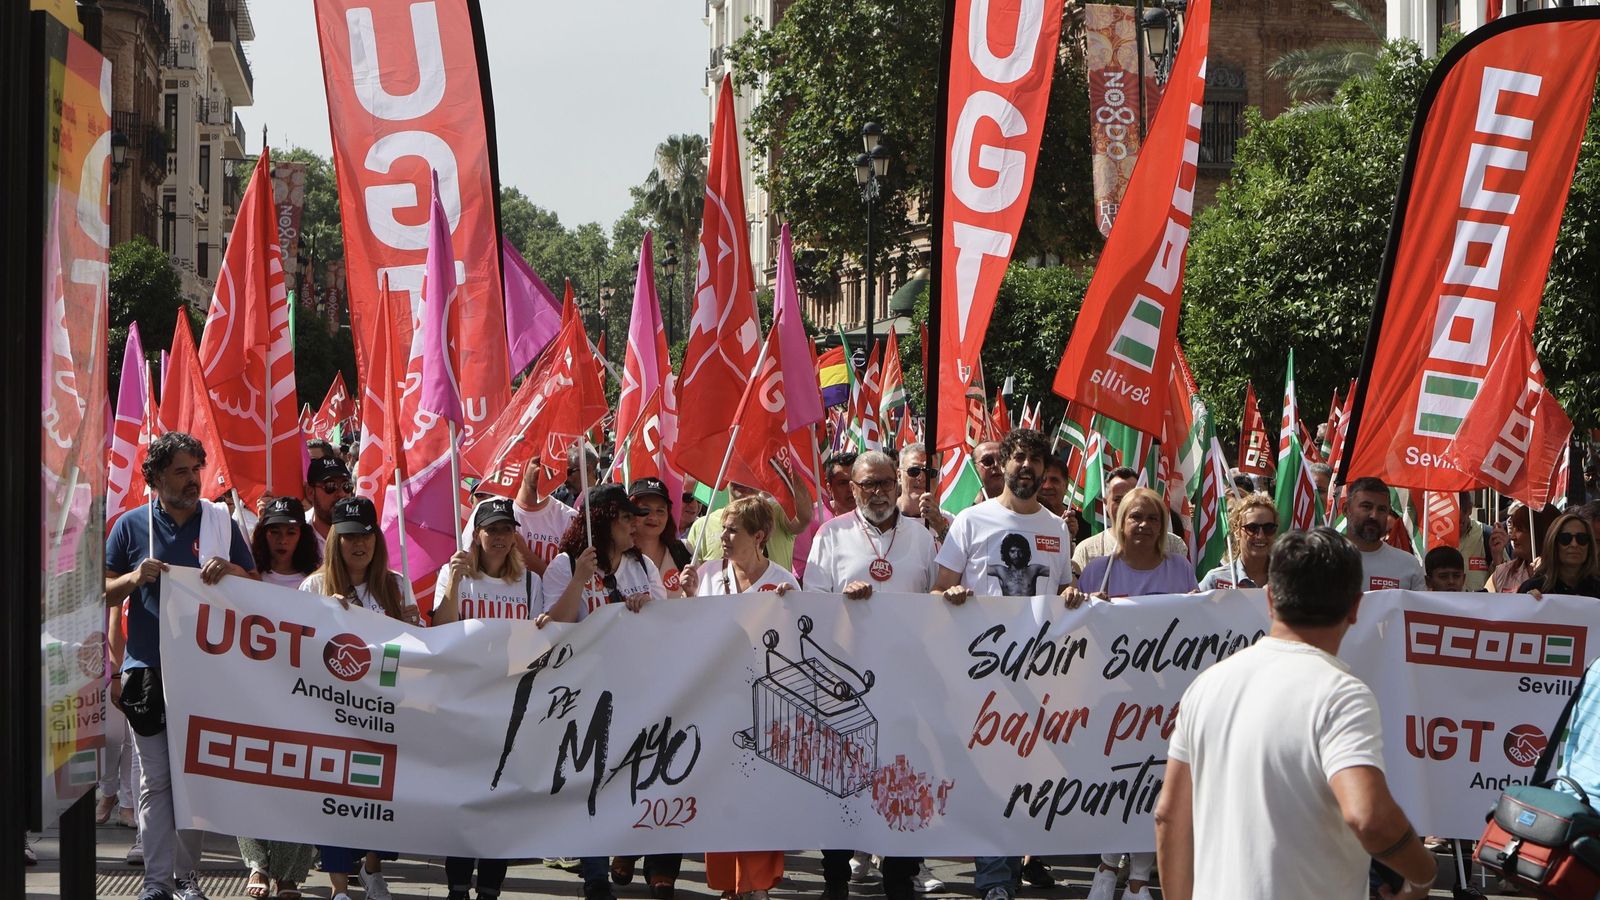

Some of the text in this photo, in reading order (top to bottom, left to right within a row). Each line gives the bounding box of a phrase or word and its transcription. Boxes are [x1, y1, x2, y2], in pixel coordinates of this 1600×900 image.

[951, 0, 1045, 343] UGT
[1428, 66, 1543, 366] CCOO
[527, 532, 560, 544] PONES
[664, 571, 680, 588] UGT
[873, 561, 889, 571] UGT
[196, 603, 316, 668] UGT
[967, 620, 1087, 682] Subir
[1409, 622, 1542, 664] CCOO
[291, 677, 396, 715] Andalucía
[538, 686, 582, 724] DE
[1518, 677, 1579, 697] Sevill
[334, 708, 395, 734] Sevilla
[968, 690, 1088, 758] bajar
[1405, 715, 1495, 763] UGT
[198, 729, 346, 785] CCOO
[322, 798, 395, 822] Sevilla
[632, 796, 698, 829] 2023
